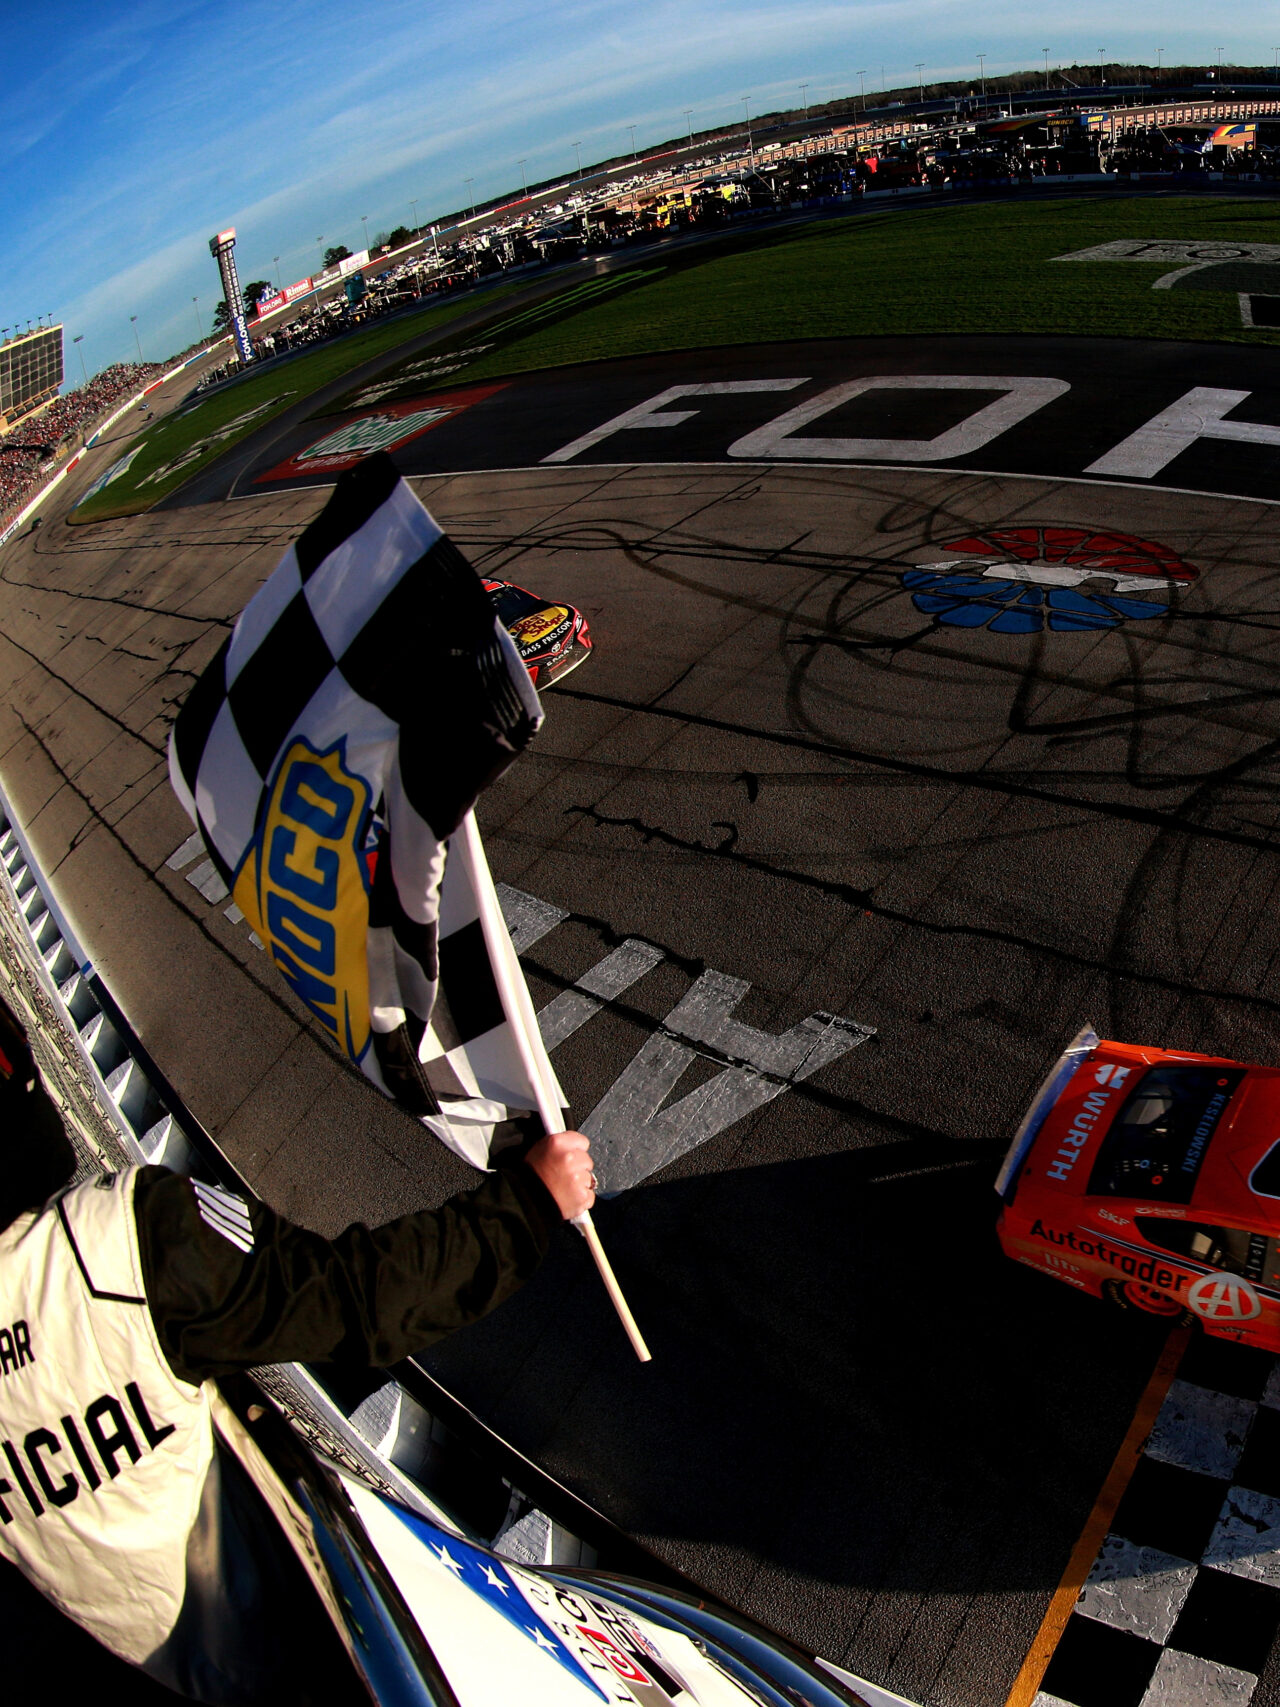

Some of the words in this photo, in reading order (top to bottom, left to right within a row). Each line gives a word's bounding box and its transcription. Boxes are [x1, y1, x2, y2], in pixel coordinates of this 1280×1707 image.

[1046, 119, 1075, 127] SUNOCO
[236, 315, 254, 362] FOH.ORG
[521, 643, 543, 658] BASS
[1046, 1091, 1114, 1182] WÜRTH
[1181, 1093, 1227, 1174] KESELOWSKI
[1097, 1208, 1131, 1226] SKF
[1030, 1219, 1189, 1291] Autotrader
